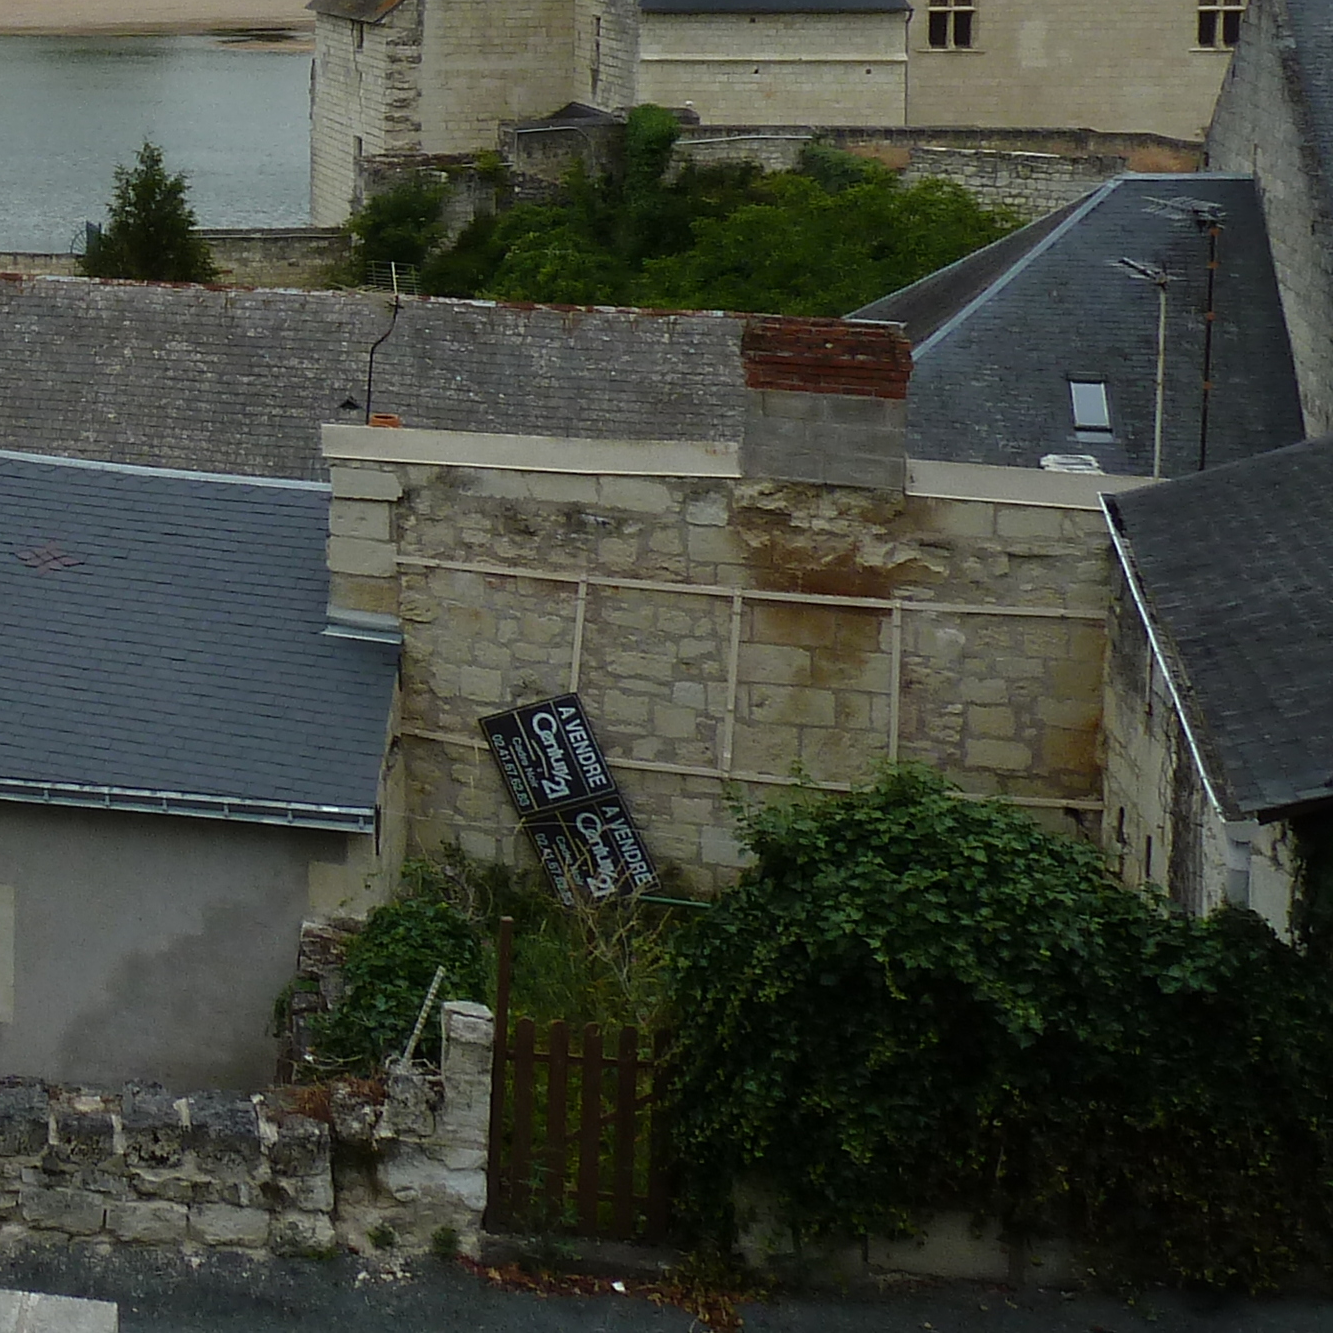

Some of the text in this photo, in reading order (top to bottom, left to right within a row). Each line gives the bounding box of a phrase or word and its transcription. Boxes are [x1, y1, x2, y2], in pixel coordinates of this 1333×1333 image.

[513, 737, 539, 788] Cadre Noir
[532, 712, 572, 799] Century 21
[558, 707, 606, 788] A VENDRE
[576, 812, 618, 898] Century 21
[602, 807, 655, 886] A VENDRE
